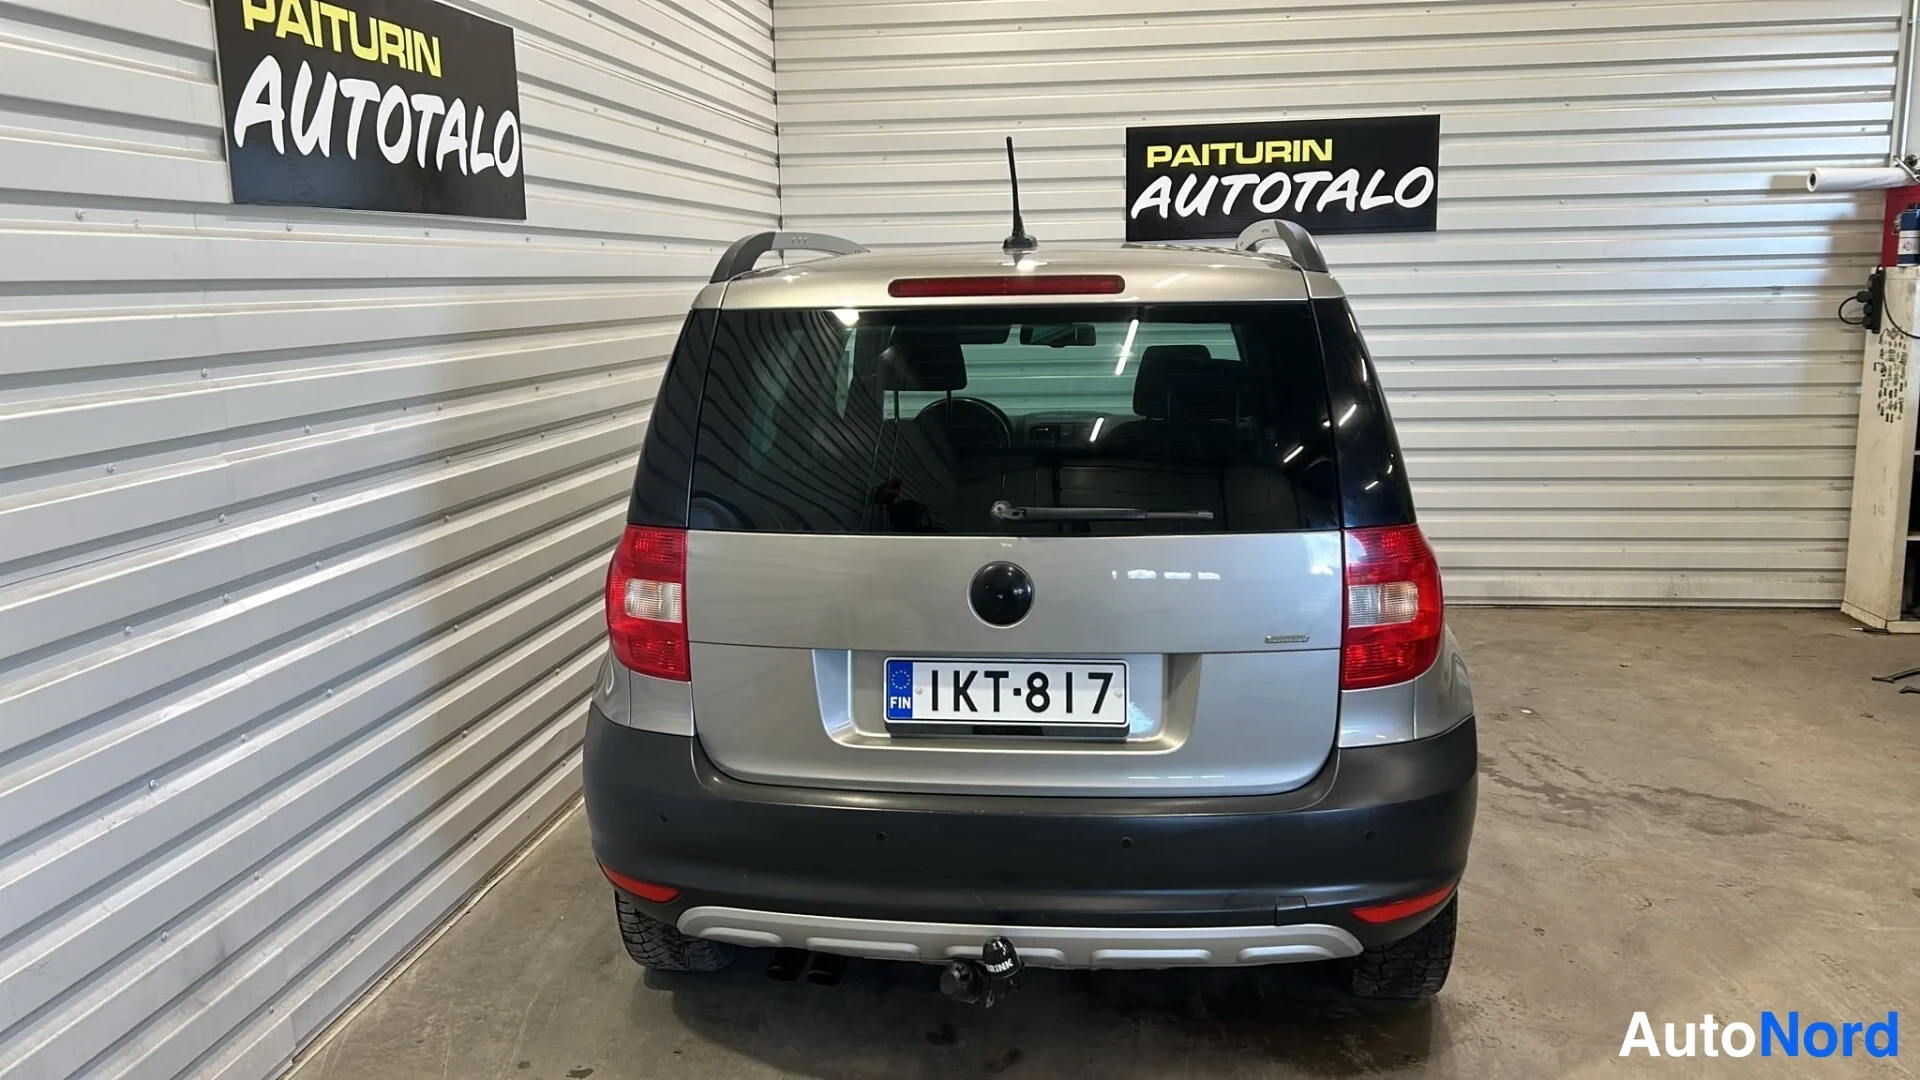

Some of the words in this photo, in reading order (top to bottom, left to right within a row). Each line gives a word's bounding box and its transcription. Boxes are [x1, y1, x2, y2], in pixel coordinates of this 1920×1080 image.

[241, 0, 442, 78] PAITURIN
[233, 55, 520, 178] AUTOTALO
[1146, 138, 1333, 169] PAITURIN
[1130, 166, 1435, 219] AUTOTALO
[889, 696, 912, 710] FIN
